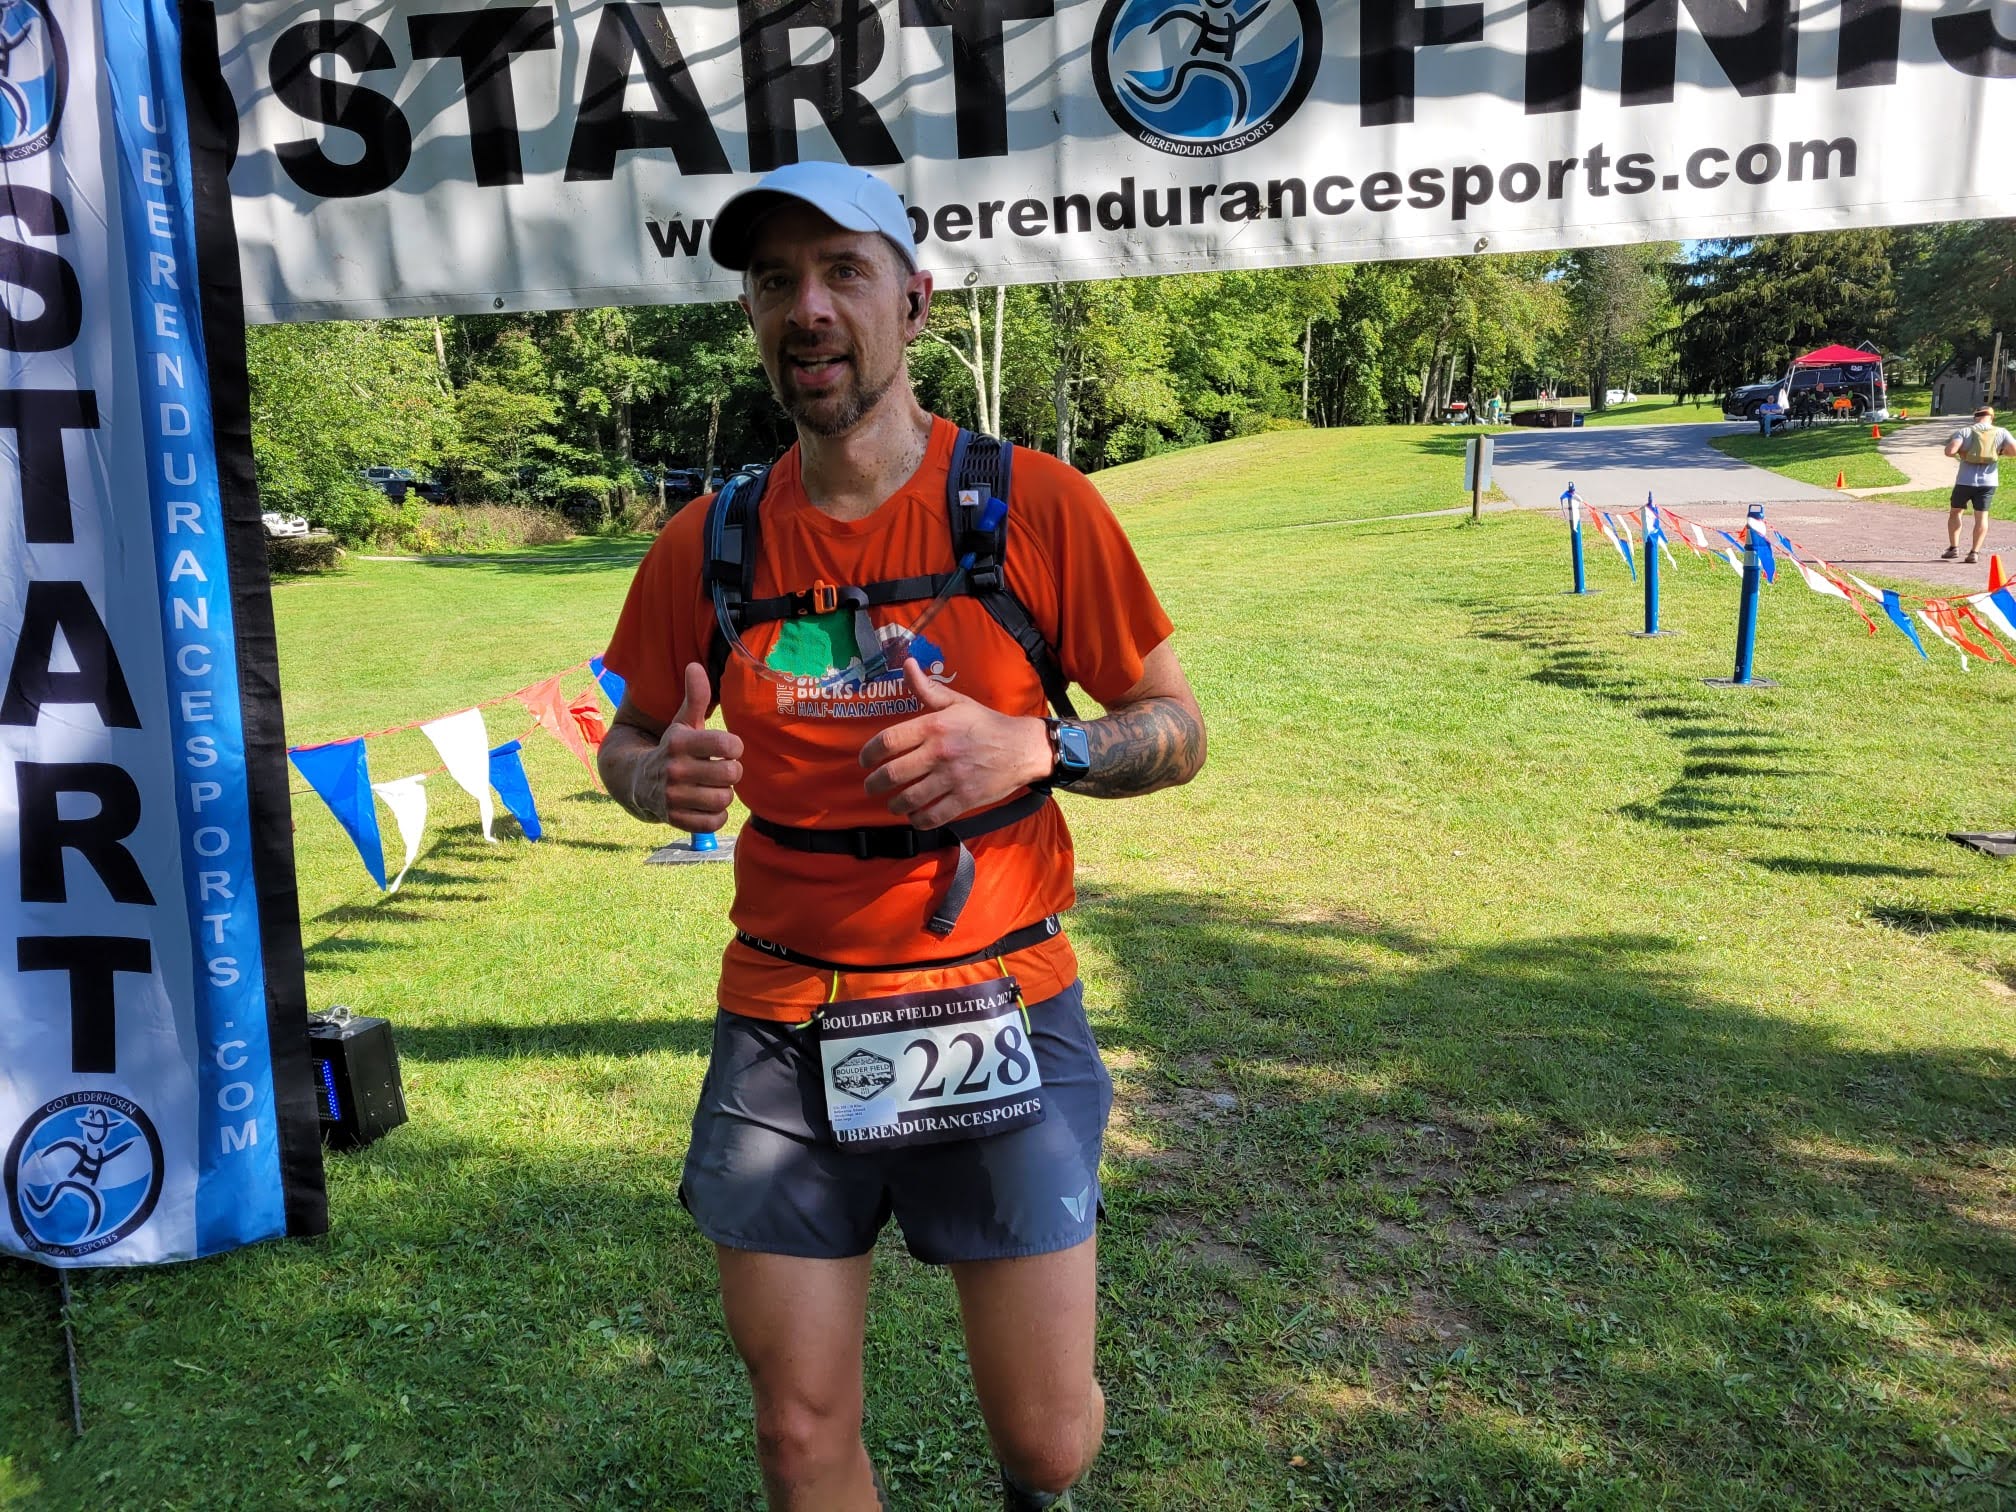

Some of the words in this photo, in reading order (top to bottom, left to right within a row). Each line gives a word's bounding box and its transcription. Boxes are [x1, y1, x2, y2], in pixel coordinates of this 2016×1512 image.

[268, 0, 1055, 198] START
[1138, 120, 1275, 157] UBERENDURANCESPORTS
[0, 184, 158, 1074] START
[138, 95, 259, 1155] UBERENDURANCESPORTS.COM
[797, 696, 919, 718] HALF-MARATHON
[858, 678, 912, 699] COUNT
[822, 1010, 894, 1031] BOULDER
[896, 1005, 943, 1022] FIELD
[946, 995, 997, 1016] ULTRA
[836, 1064, 868, 1076] BOULDER
[869, 1063, 890, 1073] FIELD
[903, 1024, 1032, 1102] 228
[46, 1096, 70, 1114] GOT
[72, 1091, 137, 1116] LEDERHOSEN
[835, 1097, 1042, 1144] UBERENDURANCESPORTS
